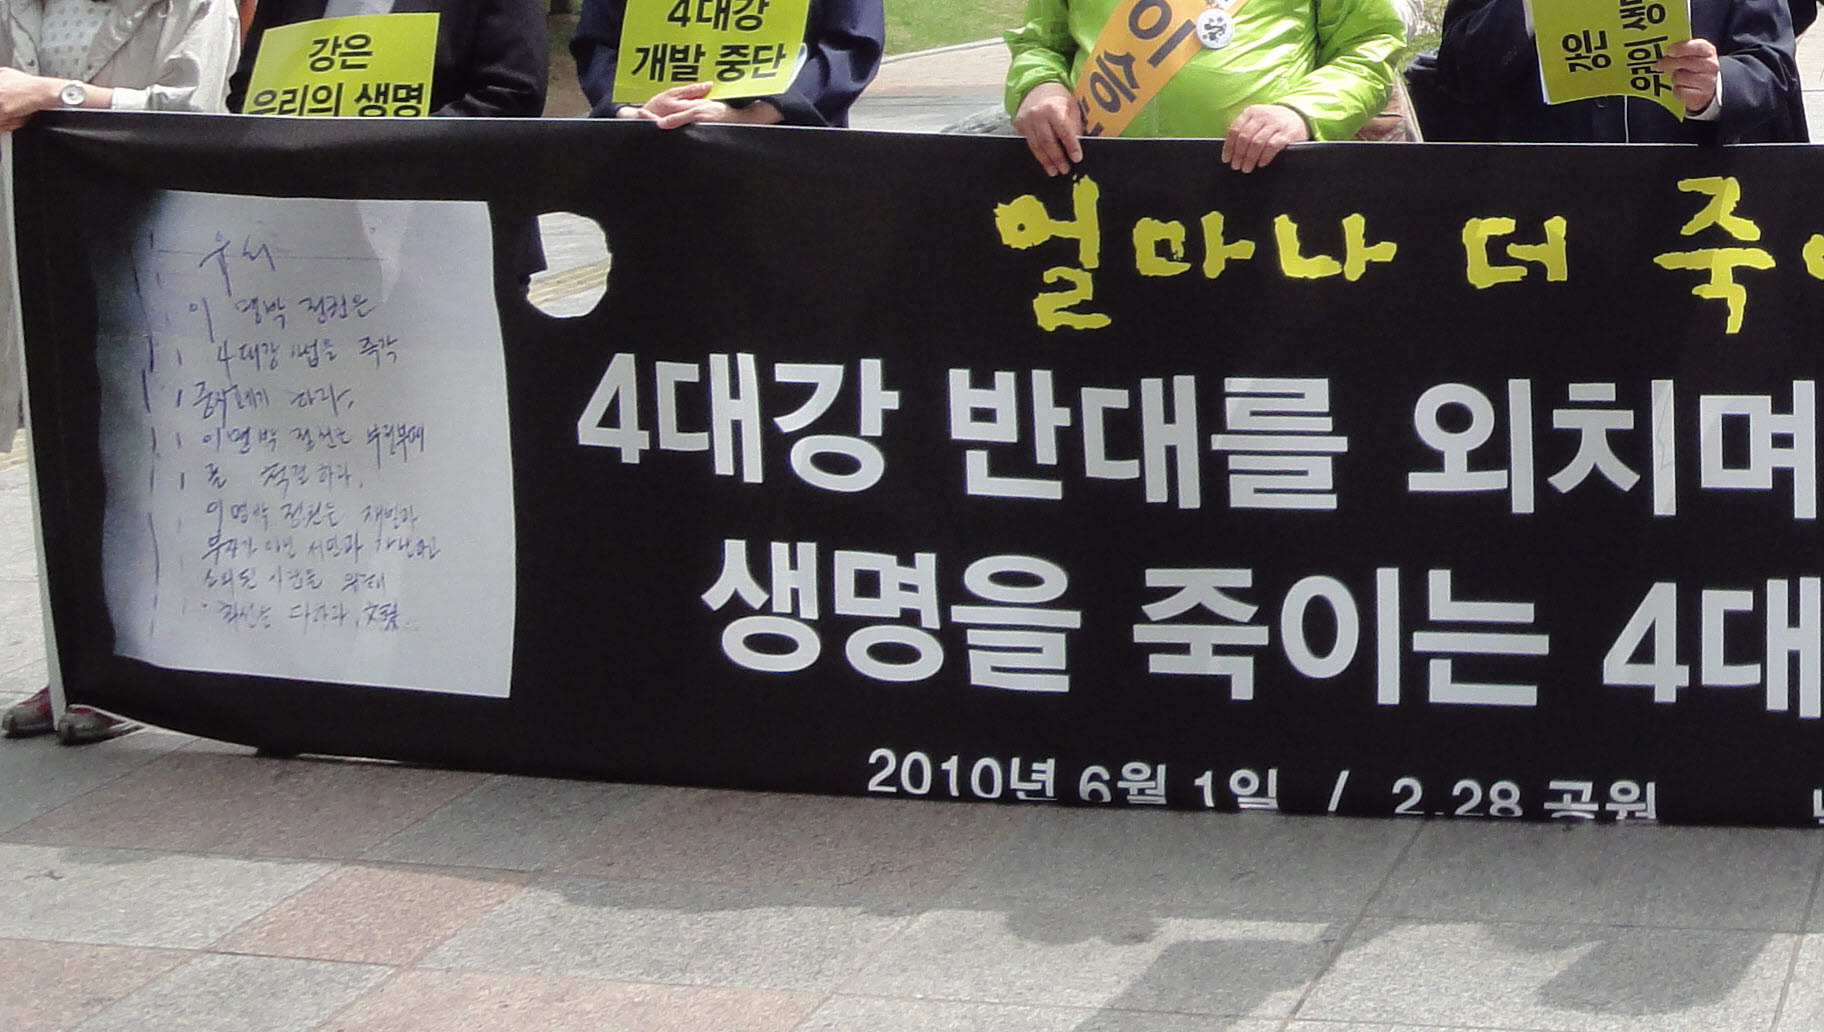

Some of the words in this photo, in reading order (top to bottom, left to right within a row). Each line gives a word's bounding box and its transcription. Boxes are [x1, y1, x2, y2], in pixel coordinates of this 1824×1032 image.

[308, 33, 374, 73] 강은
[631, 43, 706, 82] 개발
[715, 43, 786, 82] 중단
[1562, 30, 1612, 73] 강은
[1624, 35, 1673, 97] 우리의
[248, 82, 344, 117] 우리의
[354, 82, 424, 117] 생명
[993, 175, 1397, 331] 얼마나
[1462, 216, 1567, 289] 더
[578, 353, 899, 492] 4대강
[949, 369, 1348, 509] 반대를
[1408, 379, 1816, 519] 외치며
[701, 539, 1081, 692] 생명을
[1133, 568, 1549, 705] 죽이는
[868, 748, 1058, 800] 2010년
[1079, 762, 1166, 804] 6월
[1194, 768, 1278, 809] 1일
[1544, 780, 1656, 820] 공원
